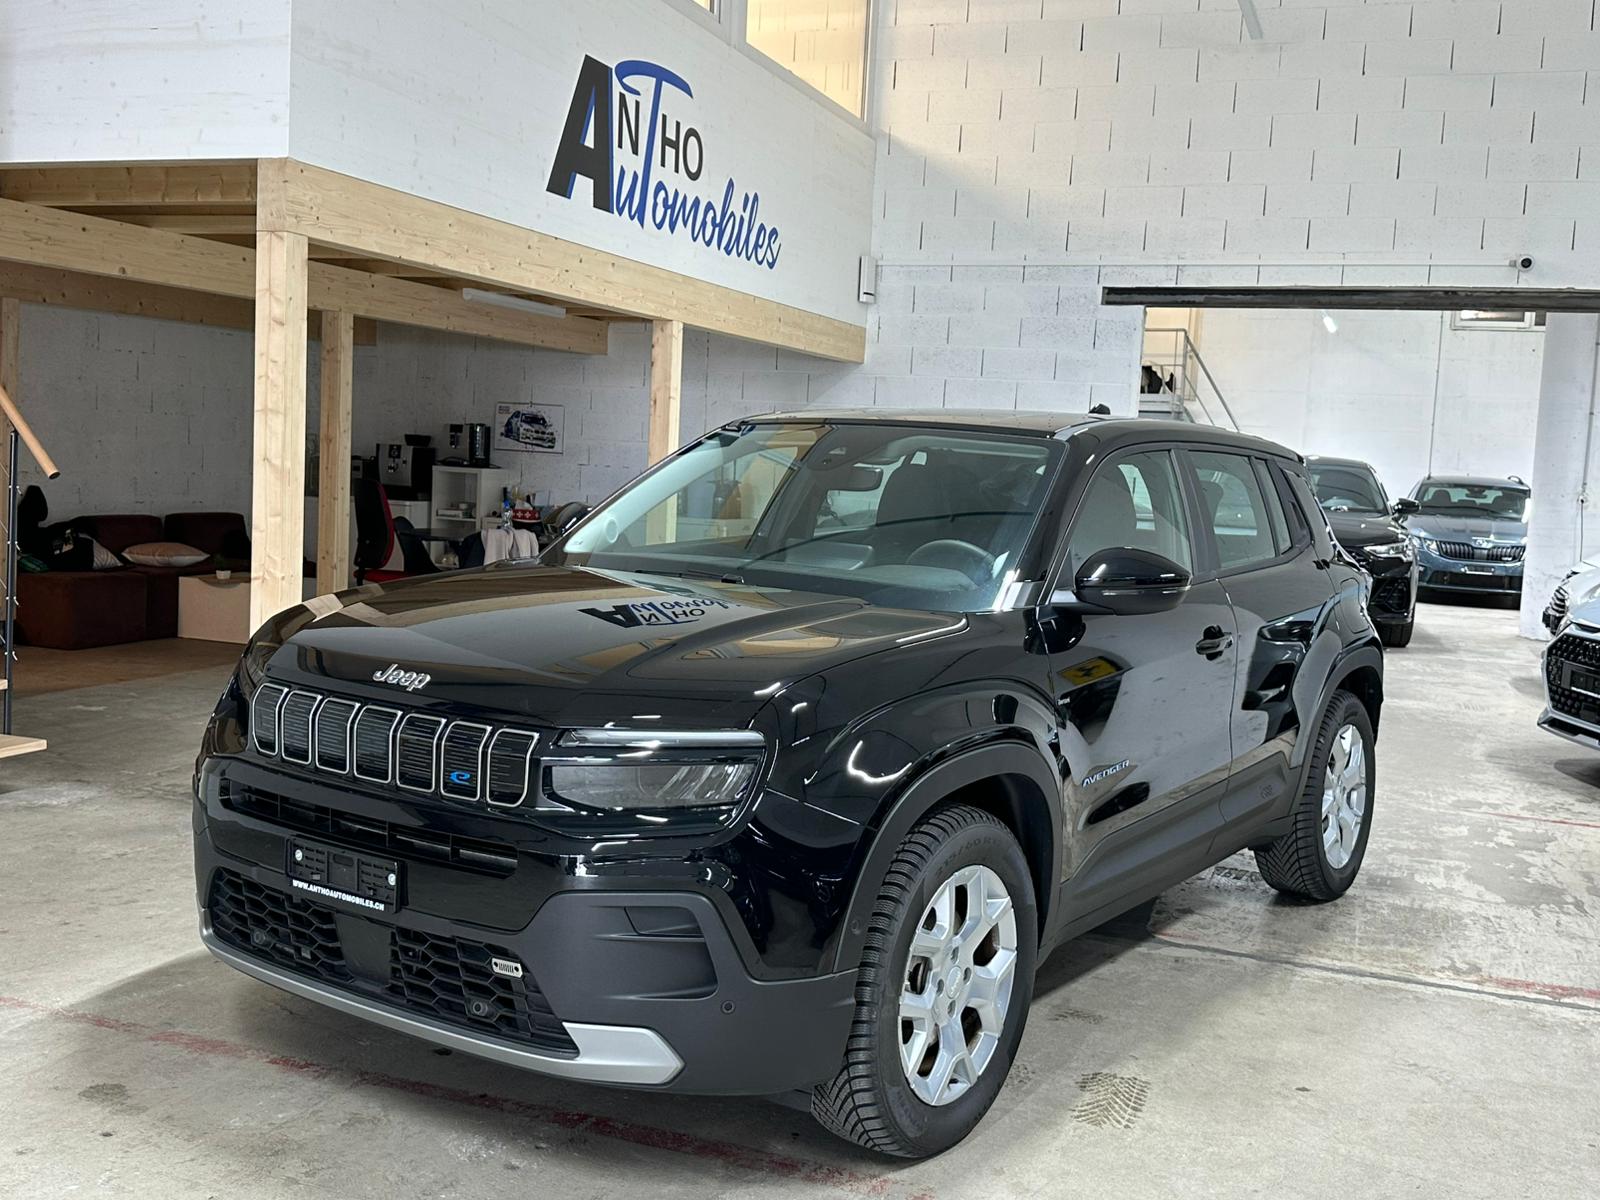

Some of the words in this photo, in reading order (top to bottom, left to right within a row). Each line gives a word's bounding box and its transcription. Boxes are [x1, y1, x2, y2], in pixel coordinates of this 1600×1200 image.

[545, 53, 704, 228] ANTHO
[373, 663, 431, 691] Jeep
[1082, 759, 1130, 788] AVENGER
[292, 879, 385, 911] WWW.ANTHOAUTOMOBILES.CH
